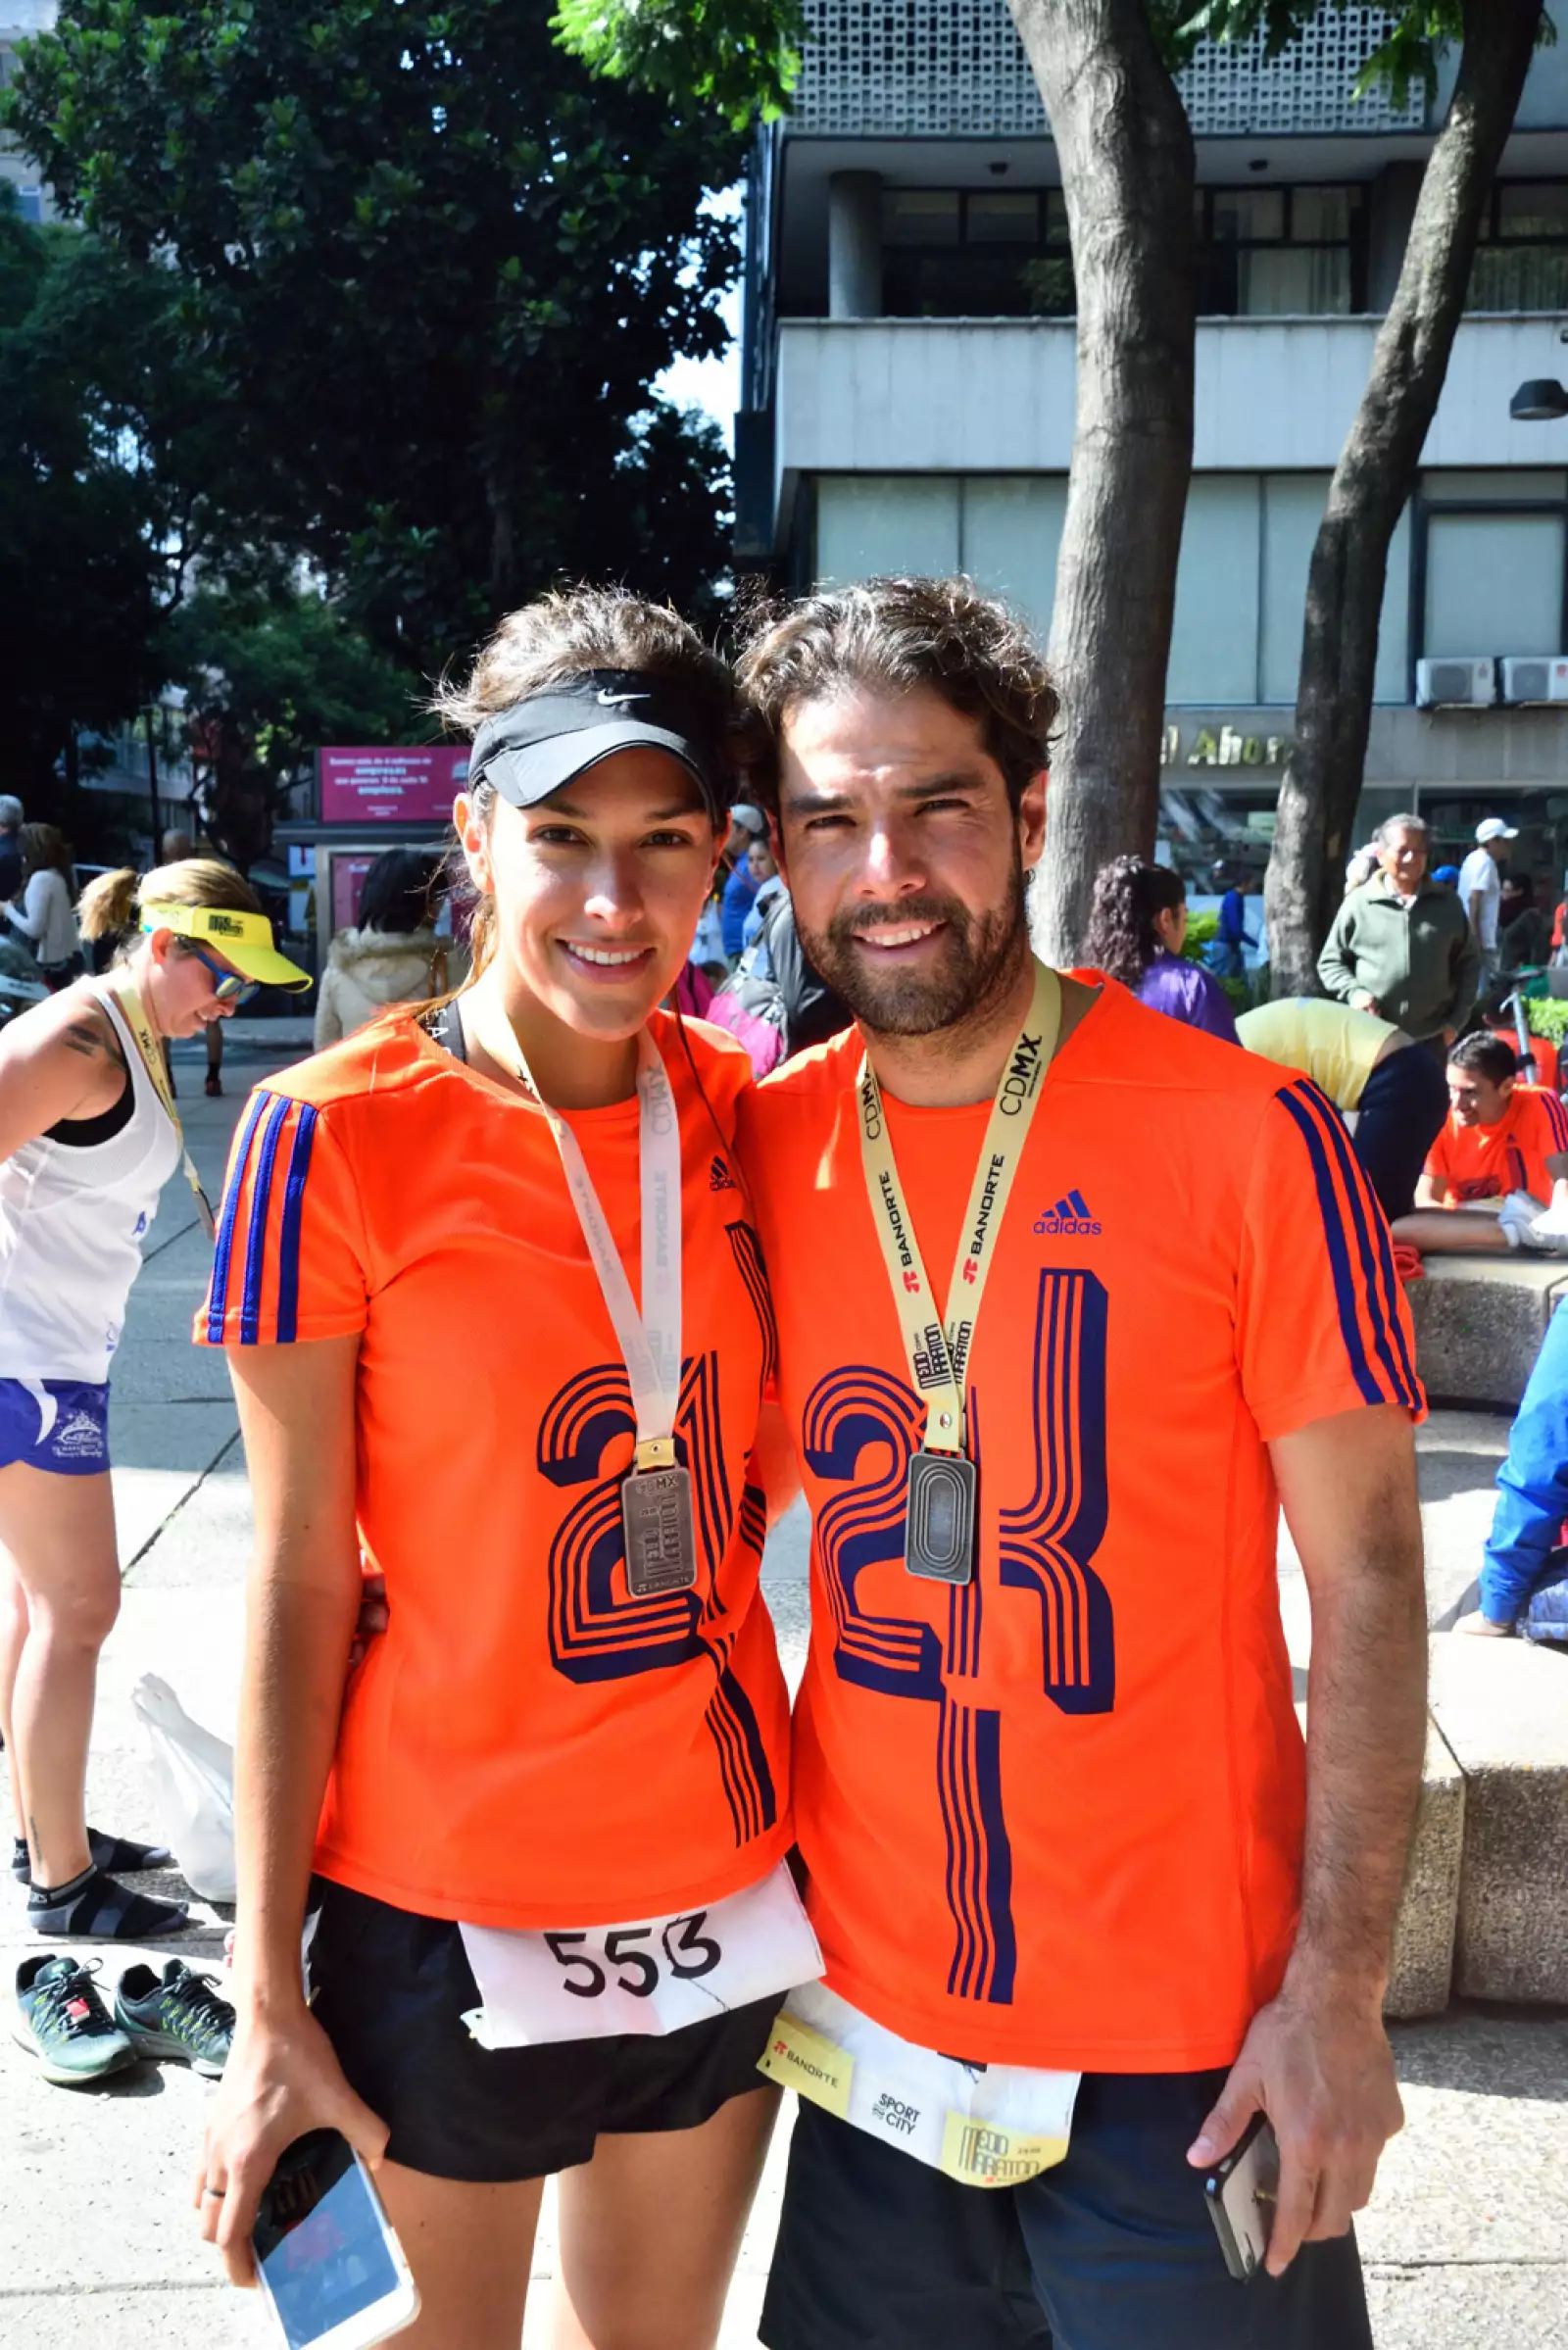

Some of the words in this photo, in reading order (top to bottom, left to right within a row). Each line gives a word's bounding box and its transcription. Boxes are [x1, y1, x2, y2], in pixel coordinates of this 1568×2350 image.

[861, 1060, 881, 1141] CDM
[1000, 1033, 1043, 1116] CDMX
[879, 1171, 913, 1267] BANORTE
[970, 1153, 1005, 1256] BANORTE
[1033, 1217, 1102, 1236] adidas
[543, 1910, 722, 1999] 553
[786, 2050, 839, 2089] BANORTE
[878, 2093, 921, 2124] SPORT
[886, 2112, 916, 2136] CITY
